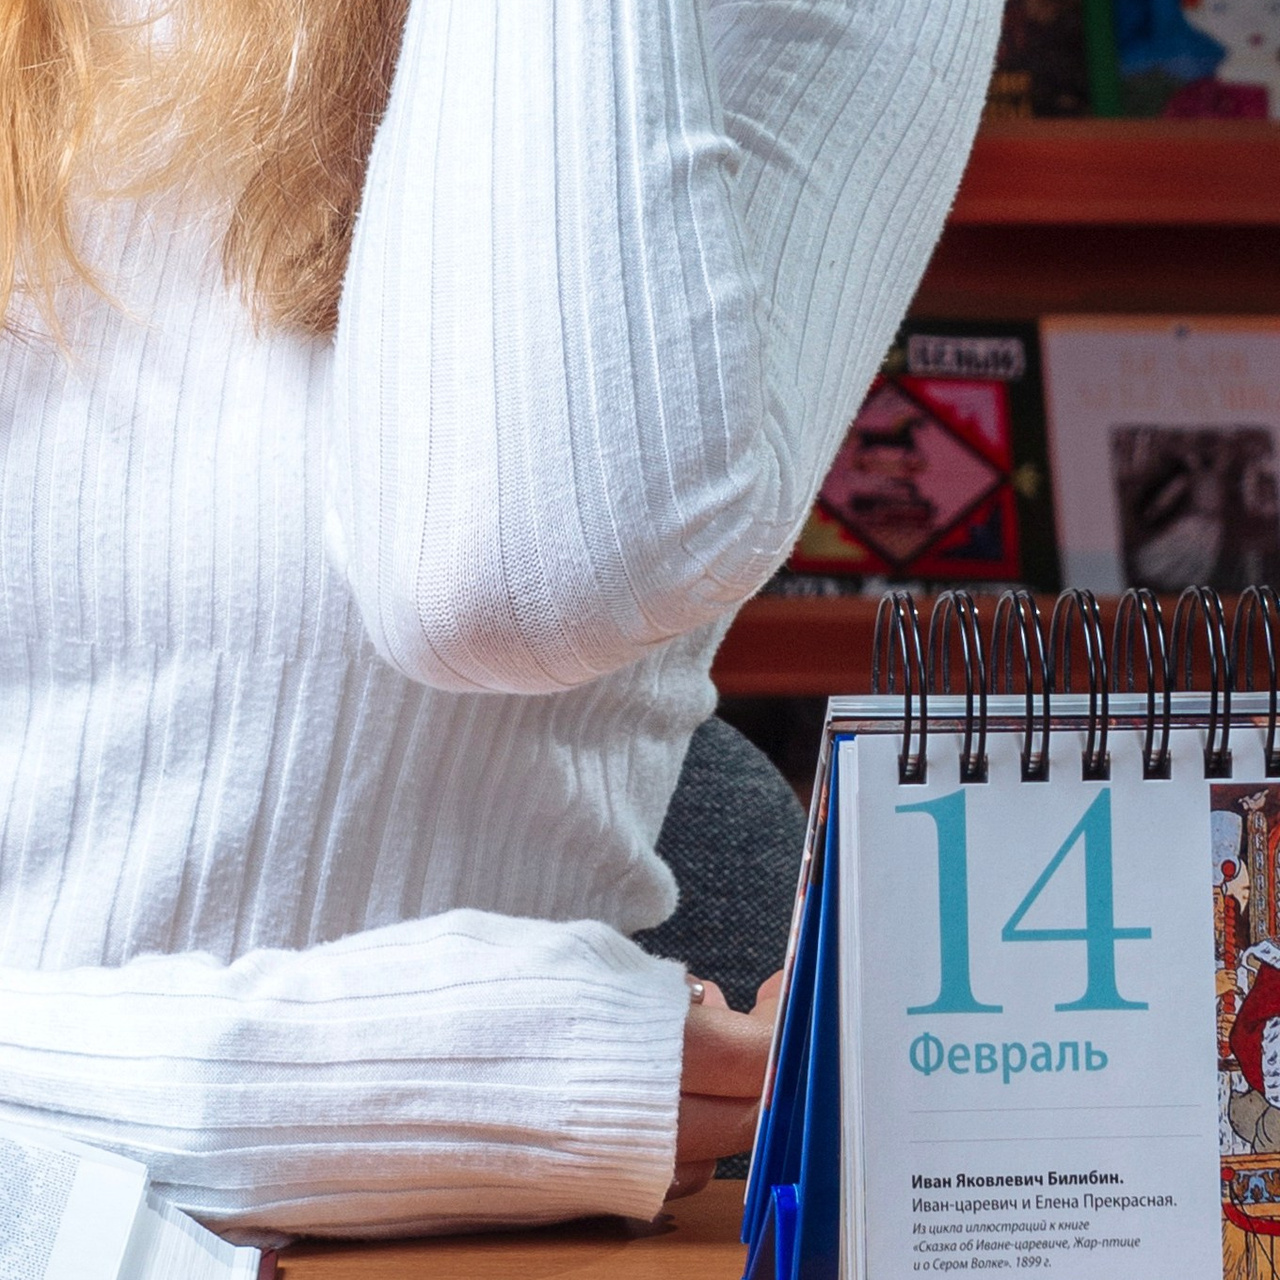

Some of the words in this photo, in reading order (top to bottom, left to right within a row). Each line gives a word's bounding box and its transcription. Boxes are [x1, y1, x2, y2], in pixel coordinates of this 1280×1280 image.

[895, 787, 1152, 1015] 14
[909, 1032, 1108, 1084] Февраль
[912, 1175, 952, 1189] Иван
[956, 1173, 1043, 1188] Яковлевич
[1048, 1170, 1124, 1186] Билибин.
[912, 1198, 1017, 1214] Иван-царевич
[1022, 1199, 1031, 1209] и
[1036, 1195, 1079, 1209] Елена
[1084, 1193, 1177, 1212] Прекрасная.
[913, 1223, 926, 1234] Из
[929, 1224, 963, 1235] цикла
[966, 1220, 1046, 1234] иллюстраций
[1049, 1222, 1056, 1231] к
[1058, 1221, 1090, 1230] книге
[913, 1240, 957, 1252] «Сказка
[959, 1239, 973, 1251] об
[976, 1239, 1070, 1252] Иване-царевиче,
[1073, 1237, 1140, 1249] Жар-птице
[913, 1262, 920, 1271] и
[923, 1261, 930, 1271] о
[933, 1258, 968, 1272] Сером
[1017, 1256, 1042, 1268] 1899
